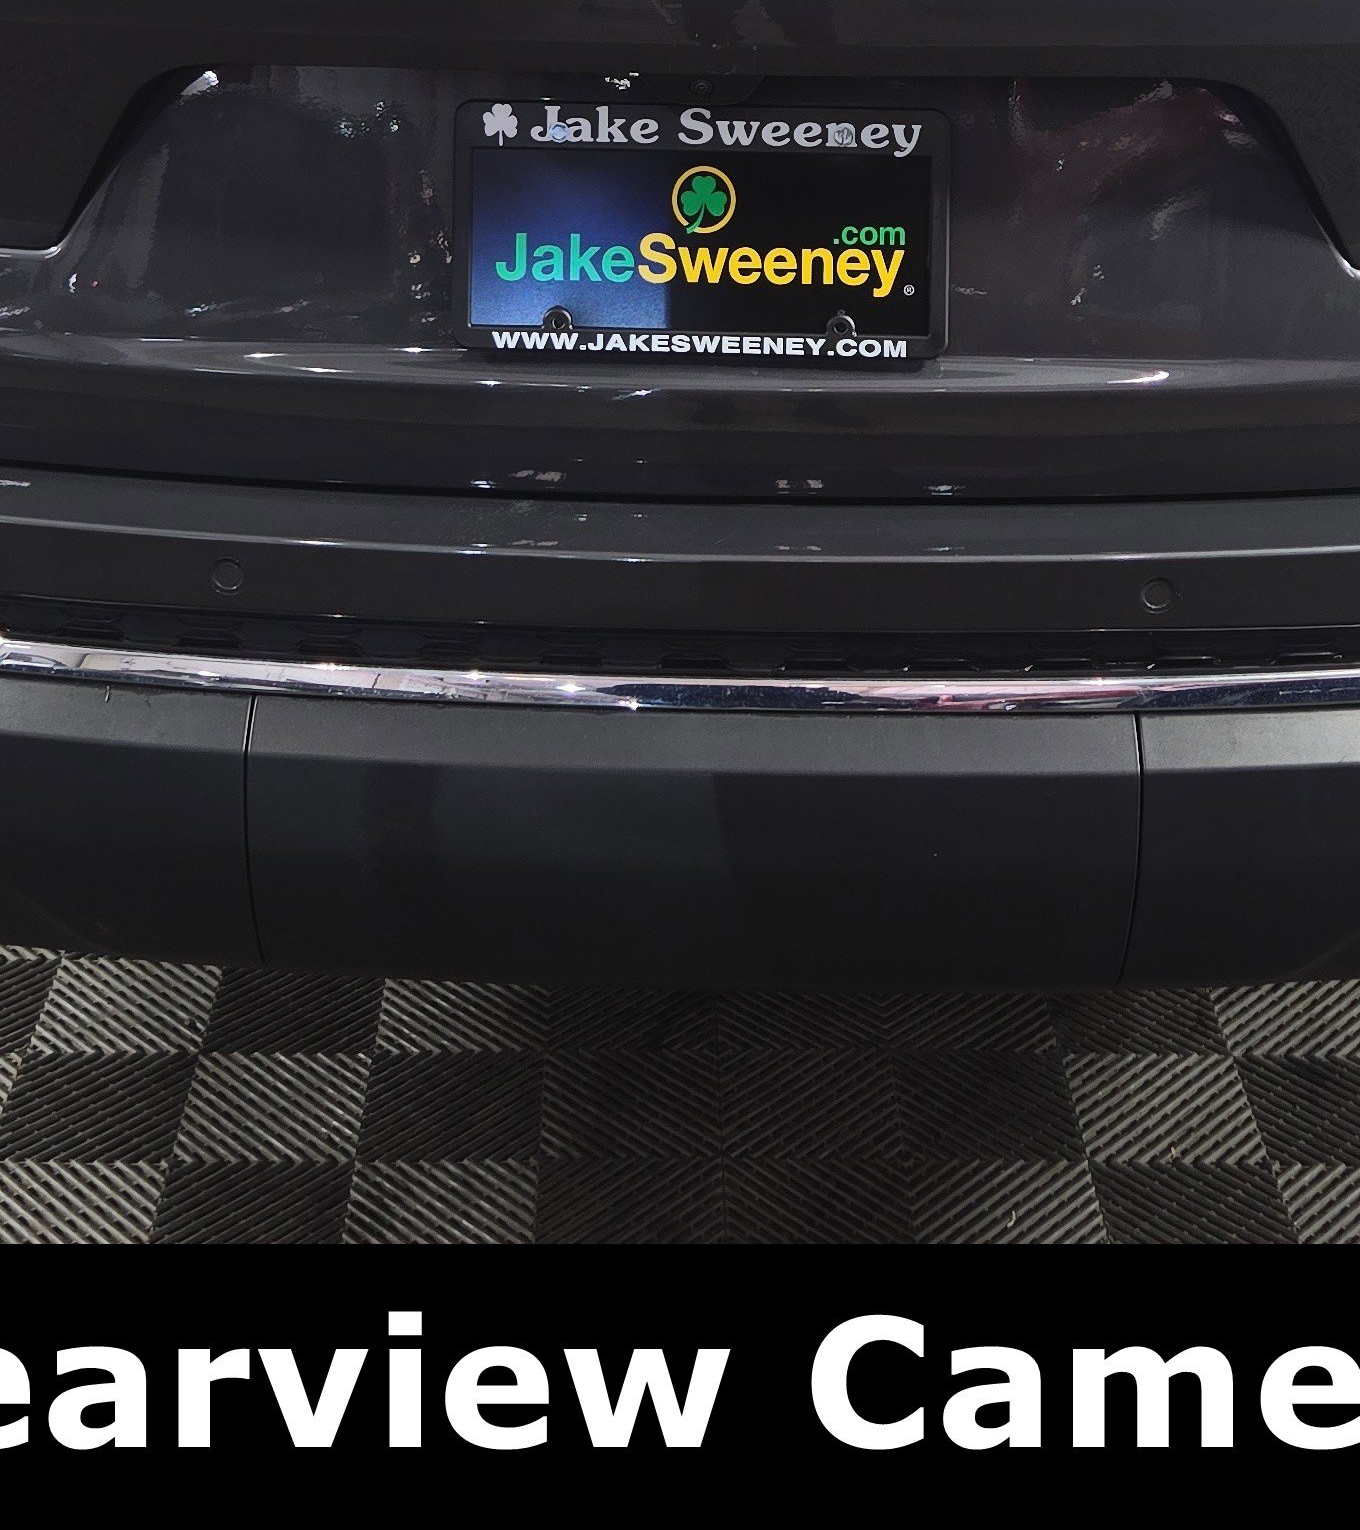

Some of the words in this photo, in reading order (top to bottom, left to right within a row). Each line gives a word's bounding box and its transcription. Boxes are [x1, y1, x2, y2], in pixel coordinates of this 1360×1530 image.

[530, 105, 660, 144] Jake
[678, 108, 923, 158] Sweeney
[833, 224, 907, 246] .com
[491, 331, 908, 358] WWW.JAKESWEENEY.COM
